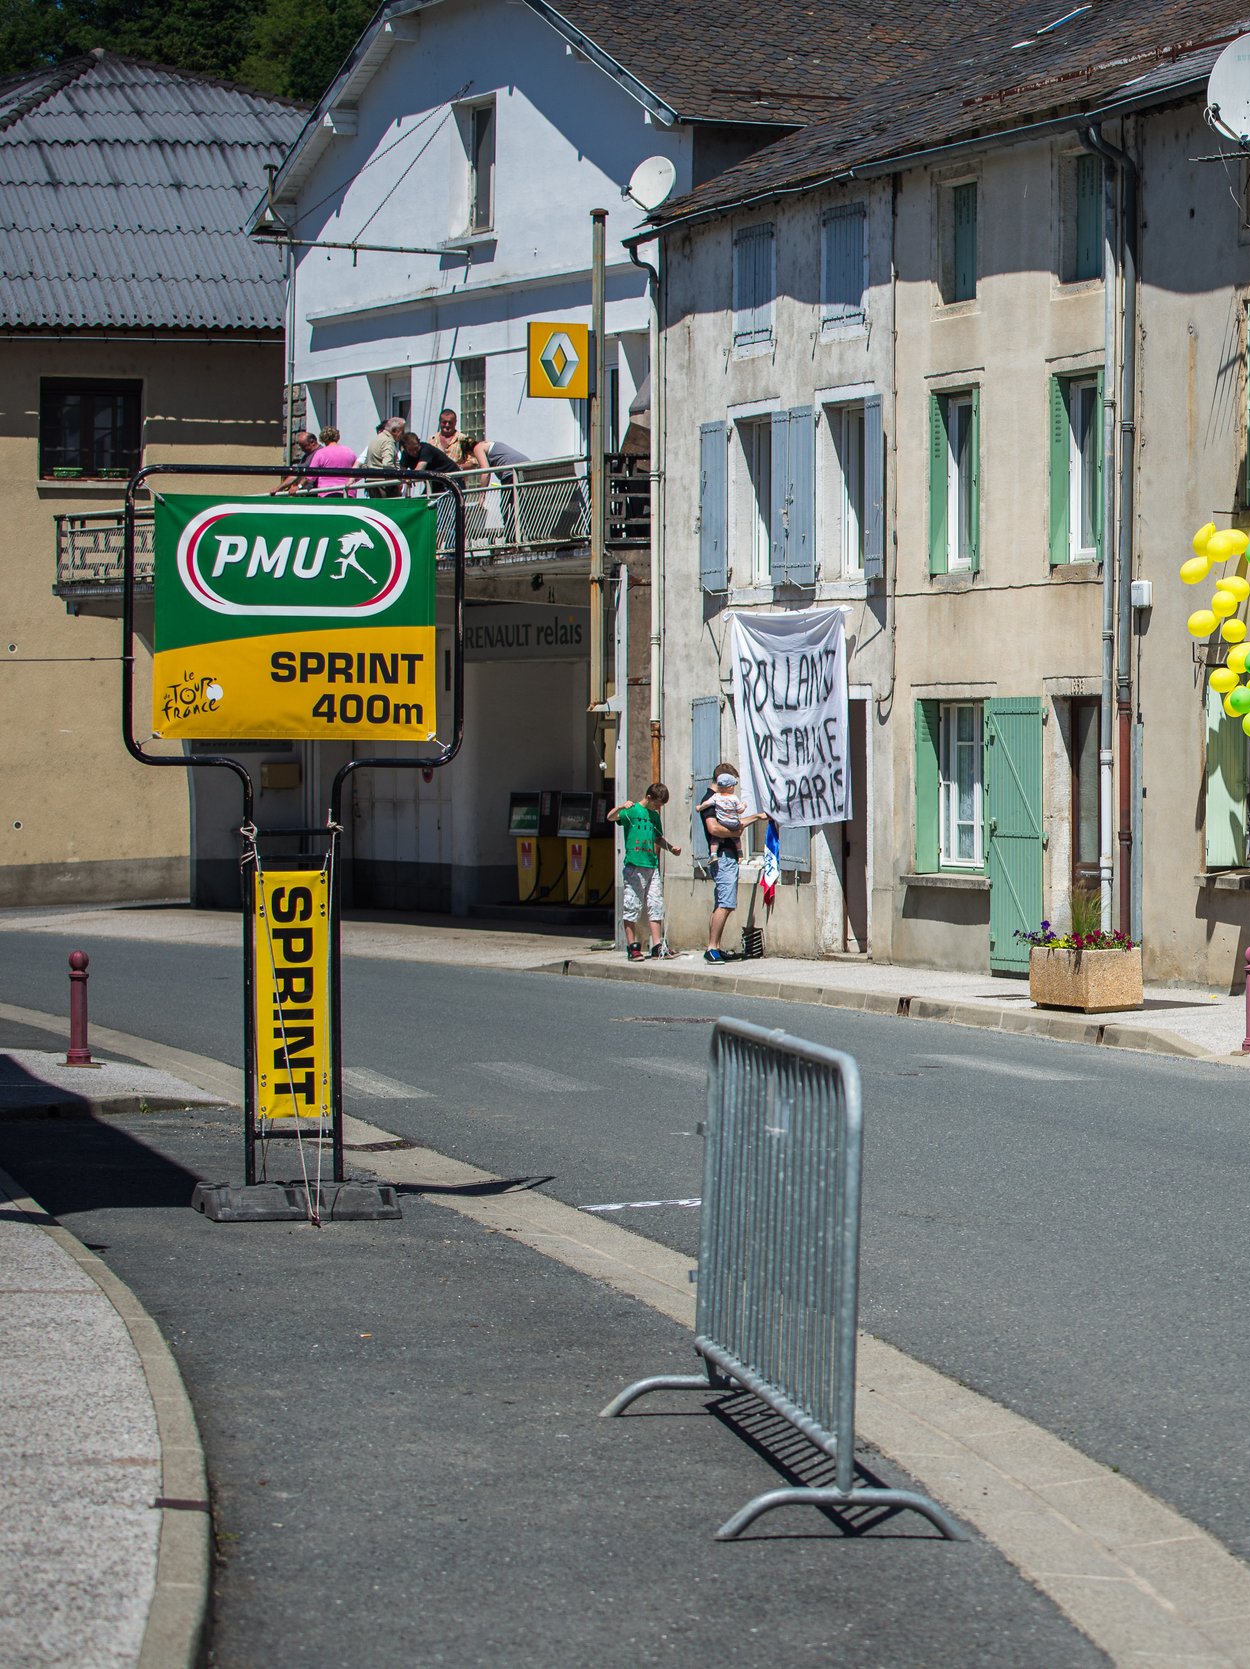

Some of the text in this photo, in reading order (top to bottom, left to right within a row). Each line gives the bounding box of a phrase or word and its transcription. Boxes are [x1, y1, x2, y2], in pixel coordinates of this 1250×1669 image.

[211, 535, 330, 579] PMU
[465, 615, 582, 648] RENAULT relais
[270, 650, 424, 685] SPRINT
[312, 693, 424, 725] 400m
[785, 762, 844, 820] PARIS
[271, 886, 316, 1106] SPRINT
